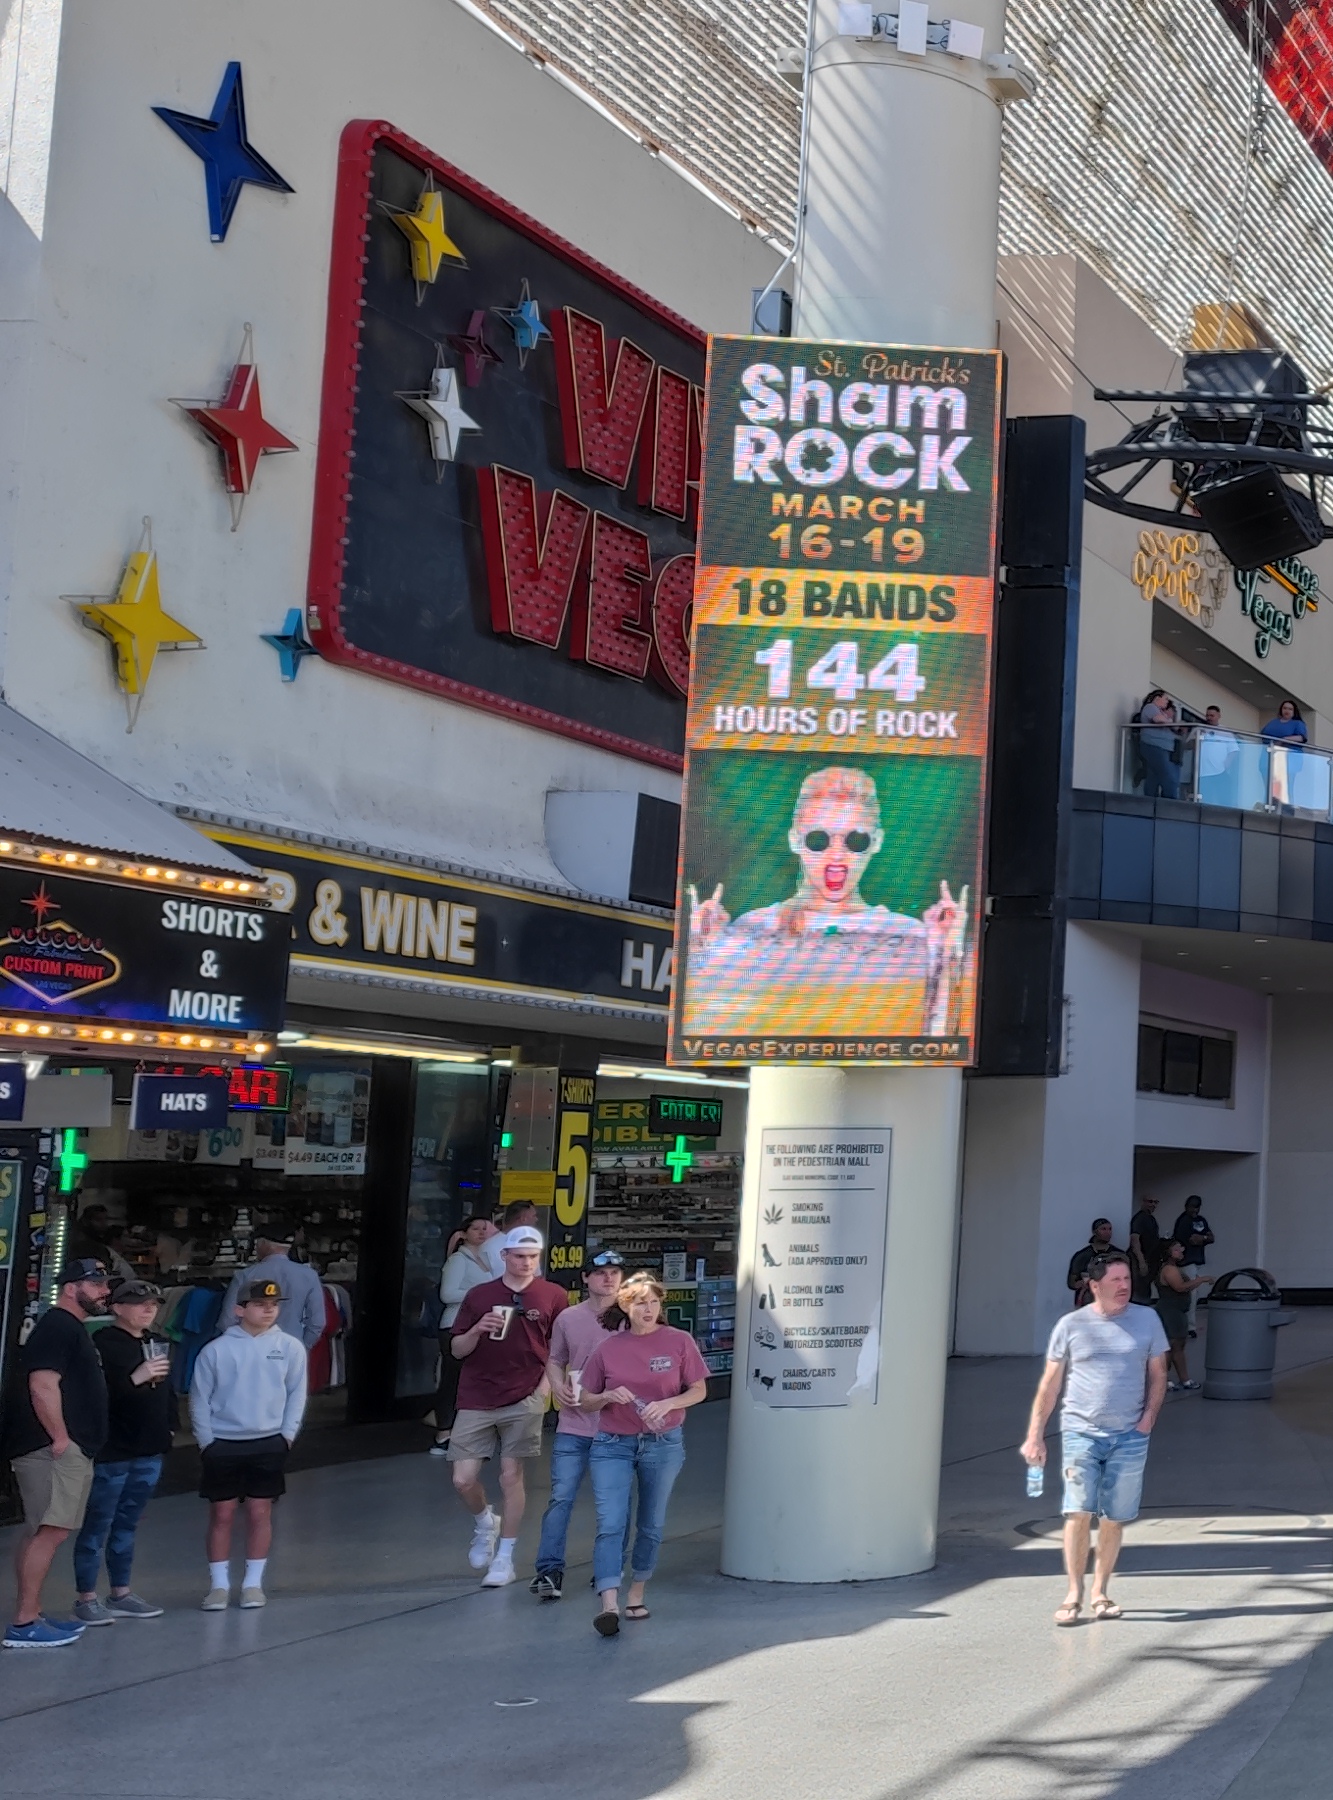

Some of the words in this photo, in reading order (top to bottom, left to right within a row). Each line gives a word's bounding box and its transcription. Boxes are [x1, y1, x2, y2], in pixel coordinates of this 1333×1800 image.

[814, 350, 849, 377] St.
[862, 352, 971, 384] Patrick's
[739, 363, 967, 430] Sham
[733, 424, 973, 492] ROCK
[771, 492, 925, 523] MARCH
[768, 523, 925, 563] 16-19
[732, 578, 787, 616] 18
[803, 580, 957, 622] BANDS
[1234, 568, 1293, 659] Vegas
[755, 639, 926, 702] 144
[714, 705, 819, 735] HOURS
[827, 708, 867, 735] OF
[875, 710, 959, 739] ROCK
[161, 900, 264, 941] SHORTS
[309, 879, 348, 947] &
[361, 887, 477, 966] WINE
[4, 955, 61, 975] CUSTOM
[65, 963, 105, 979] PRINT
[200, 950, 219, 978] &
[168, 989, 243, 1024] MORE
[160, 1093, 207, 1111] HATS
[561, 1077, 594, 1105] T-SHIRTS
[288, 1152, 312, 1164] $4.49
[314, 1153, 339, 1163] EACH
[340, 1153, 354, 1163] OR
[355, 1153, 362, 1163] 2
[766, 1145, 775, 1154] THE
[777, 1144, 817, 1154] FOLLOWING
[818, 1144, 834, 1154] ARE
[835, 1144, 884, 1154] PROHIBITED
[783, 1157, 796, 1167] THE
[798, 1156, 845, 1167] PEDESTRIAN
[848, 1156, 870, 1167] MALL
[555, 1111, 589, 1226] 5
[792, 1203, 824, 1212] SMOKING
[791, 1216, 831, 1225] MARIJUANA
[550, 1246, 583, 1271] $9.99
[789, 1244, 820, 1253] ANIMALS
[806, 1256, 843, 1266] APPROVED
[845, 1255, 867, 1266] ONLY)
[784, 1286, 813, 1295] ALCOHOL
[815, 1286, 823, 1294] IN
[824, 1285, 844, 1294] CANS
[793, 1298, 823, 1307] BOTTLES
[783, 1338, 823, 1348] MOTORIZED
[825, 1338, 862, 1348] SCOOTERS
[784, 1326, 870, 1336] BICYCLES/SKATEBOARD
[783, 1368, 836, 1378] CHAIRS/CARTS
[782, 1381, 812, 1391] WAGONS
